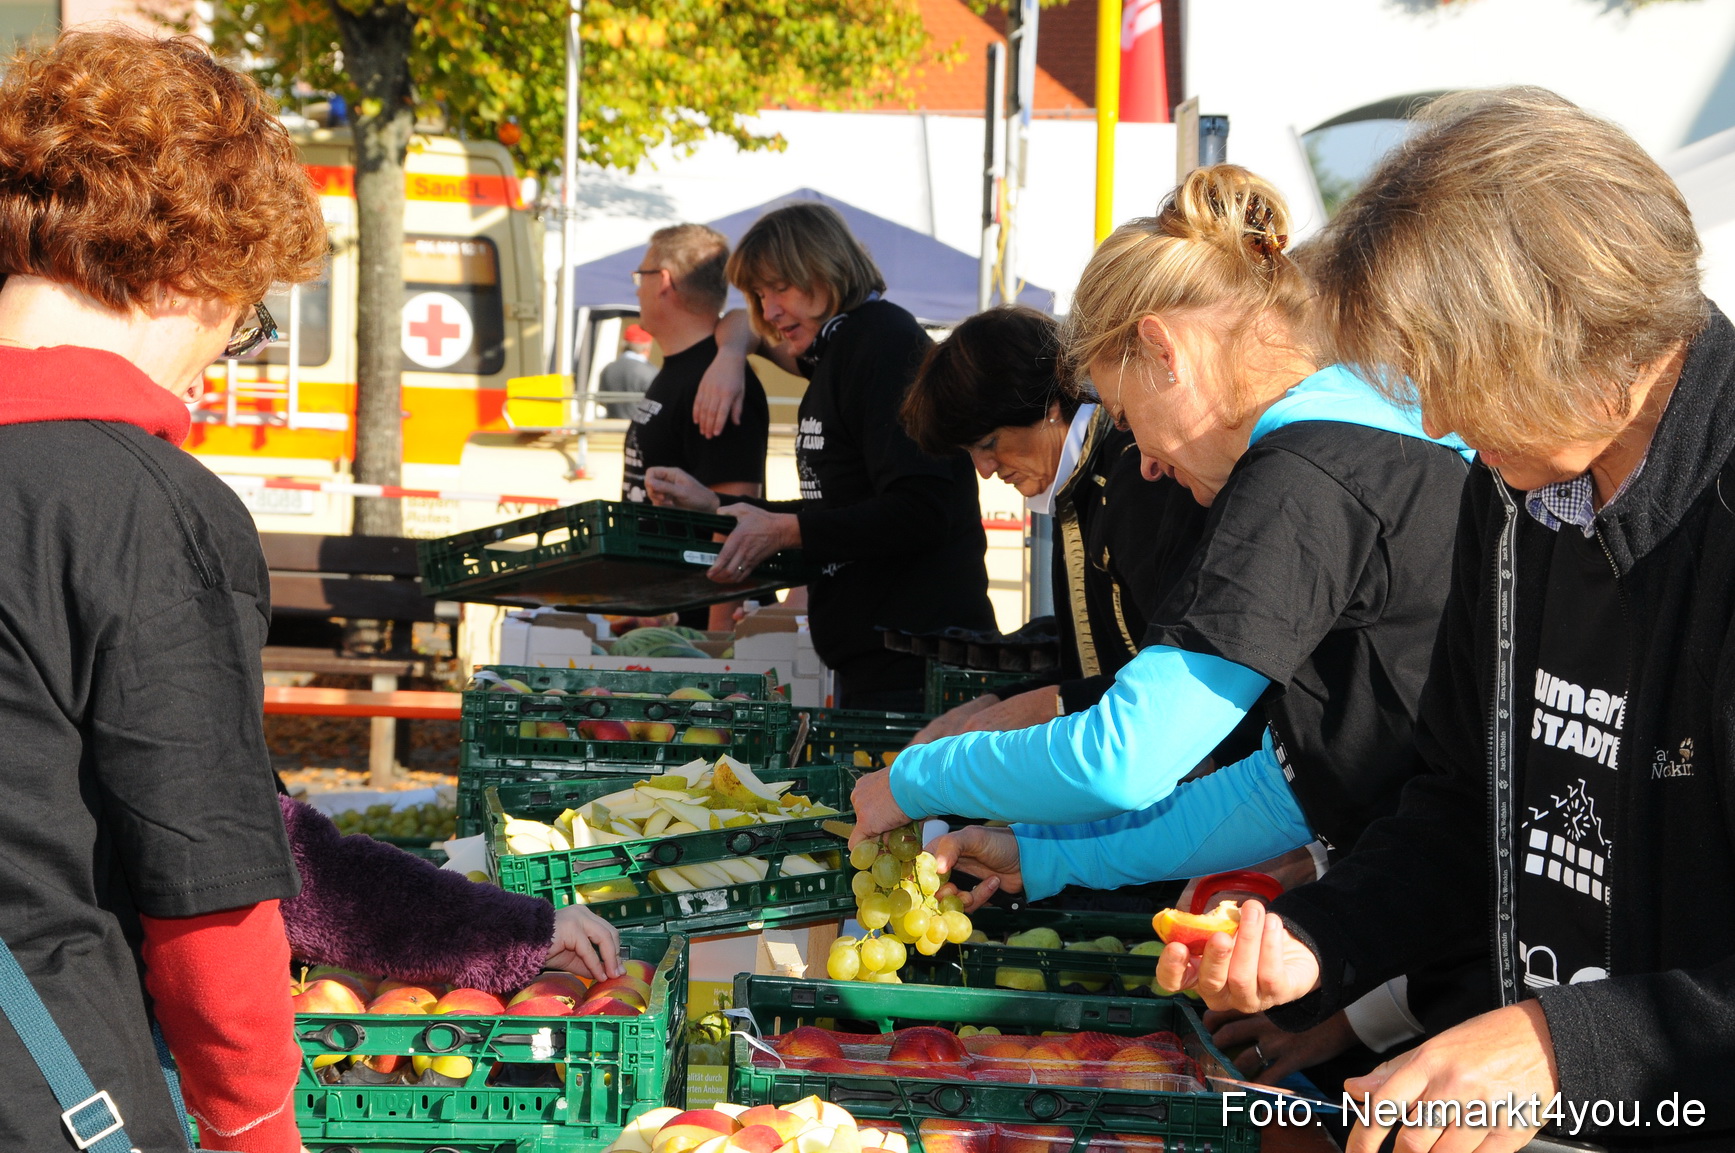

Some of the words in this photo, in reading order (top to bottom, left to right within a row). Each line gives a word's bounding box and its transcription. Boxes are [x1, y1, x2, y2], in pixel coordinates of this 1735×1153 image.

[415, 177, 487, 199] SanEL
[687, 1072, 704, 1082] alität
[704, 1073, 723, 1082] durch
[686, 1085, 702, 1094] erten
[703, 1085, 725, 1094] Anbau:
